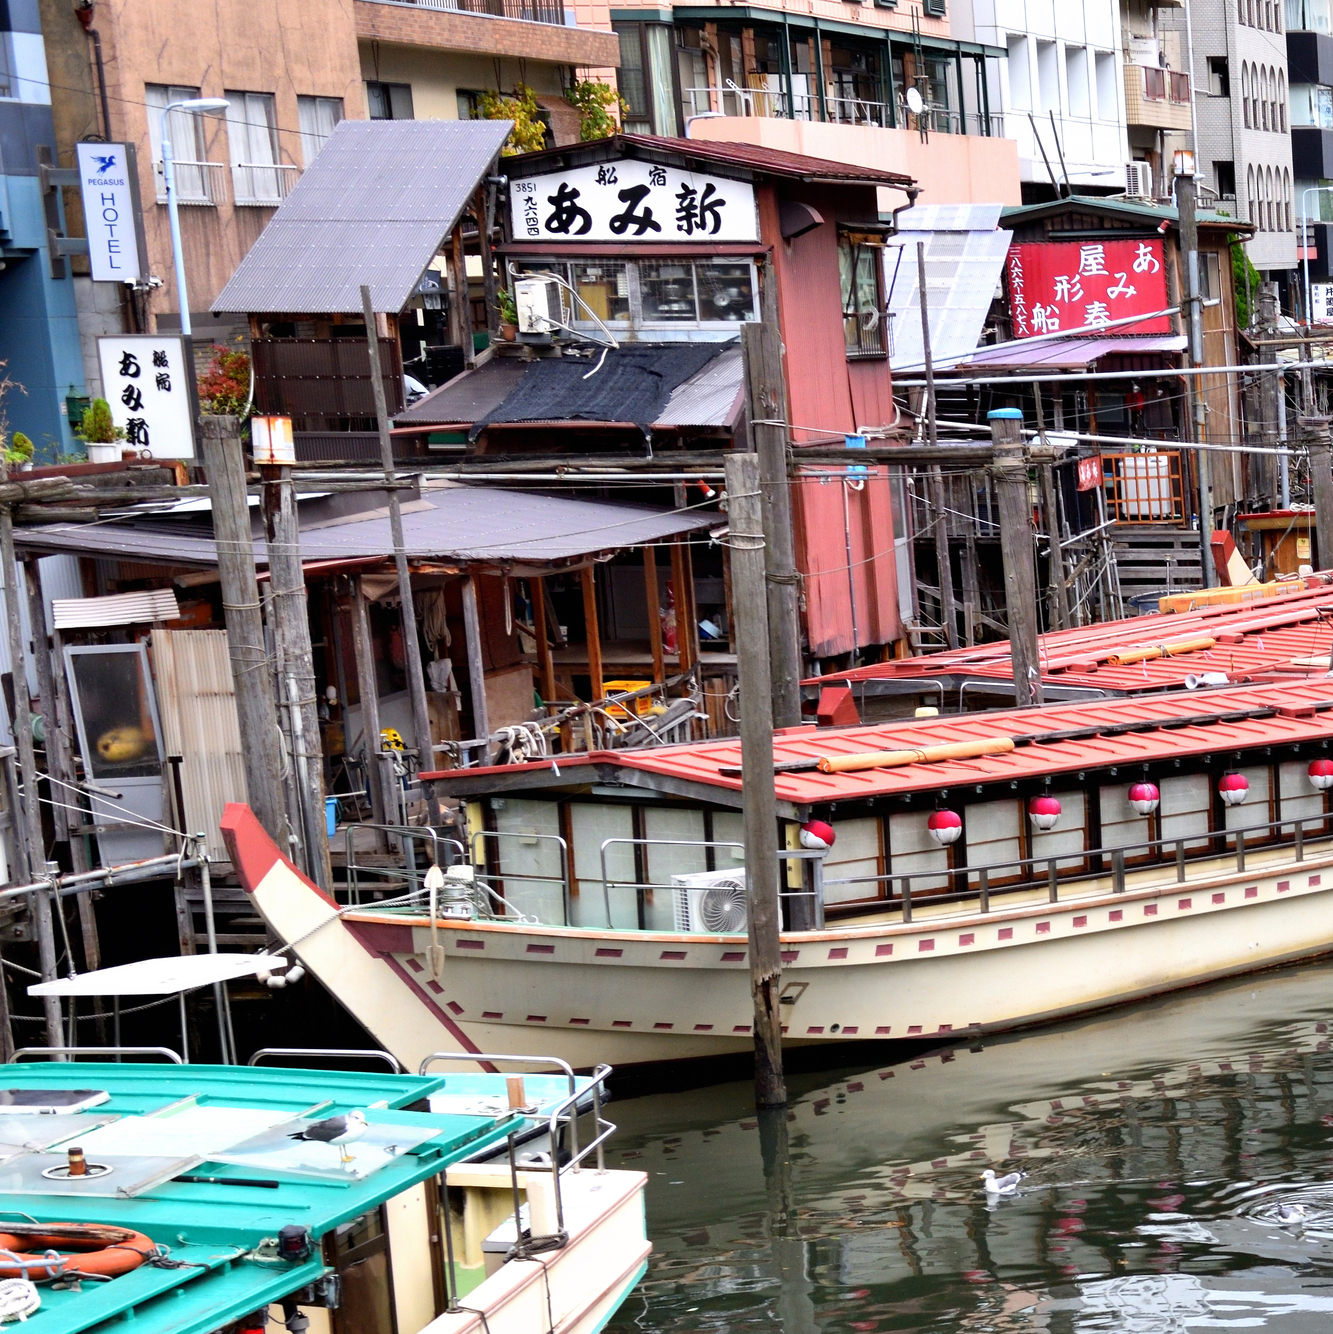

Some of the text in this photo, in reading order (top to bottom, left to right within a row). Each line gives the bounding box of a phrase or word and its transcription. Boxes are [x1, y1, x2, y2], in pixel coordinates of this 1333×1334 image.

[87, 178, 125, 186] PEGASUS
[515, 182, 538, 193] 3851
[544, 181, 727, 236] あみ新
[100, 192, 122, 270] HOTEL
[523, 195, 540, 236] 九六四四
[1030, 244, 1110, 334] 屋形船
[118, 350, 150, 446] あみ新
